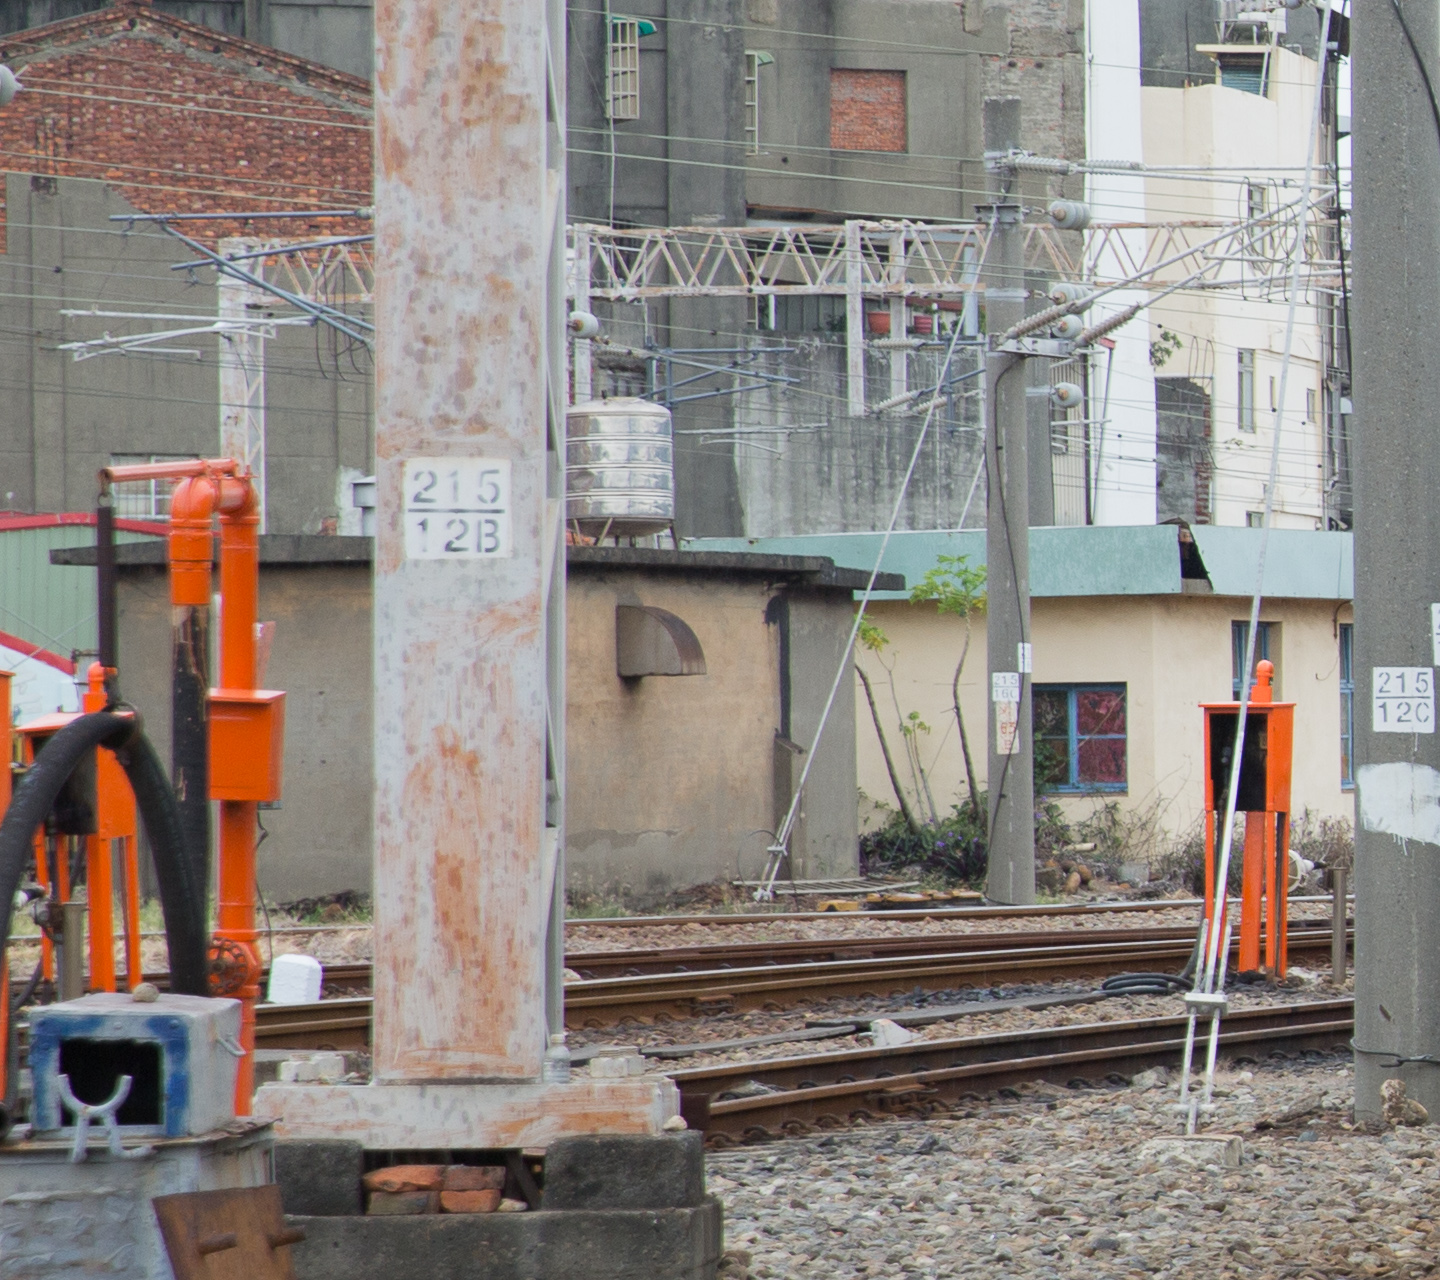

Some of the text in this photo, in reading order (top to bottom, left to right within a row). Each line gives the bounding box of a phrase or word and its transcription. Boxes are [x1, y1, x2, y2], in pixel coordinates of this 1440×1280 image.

[413, 469, 500, 504] 215
[417, 518, 500, 553] 12B
[1378, 672, 1429, 693] 215
[1378, 701, 1430, 723] 12C
